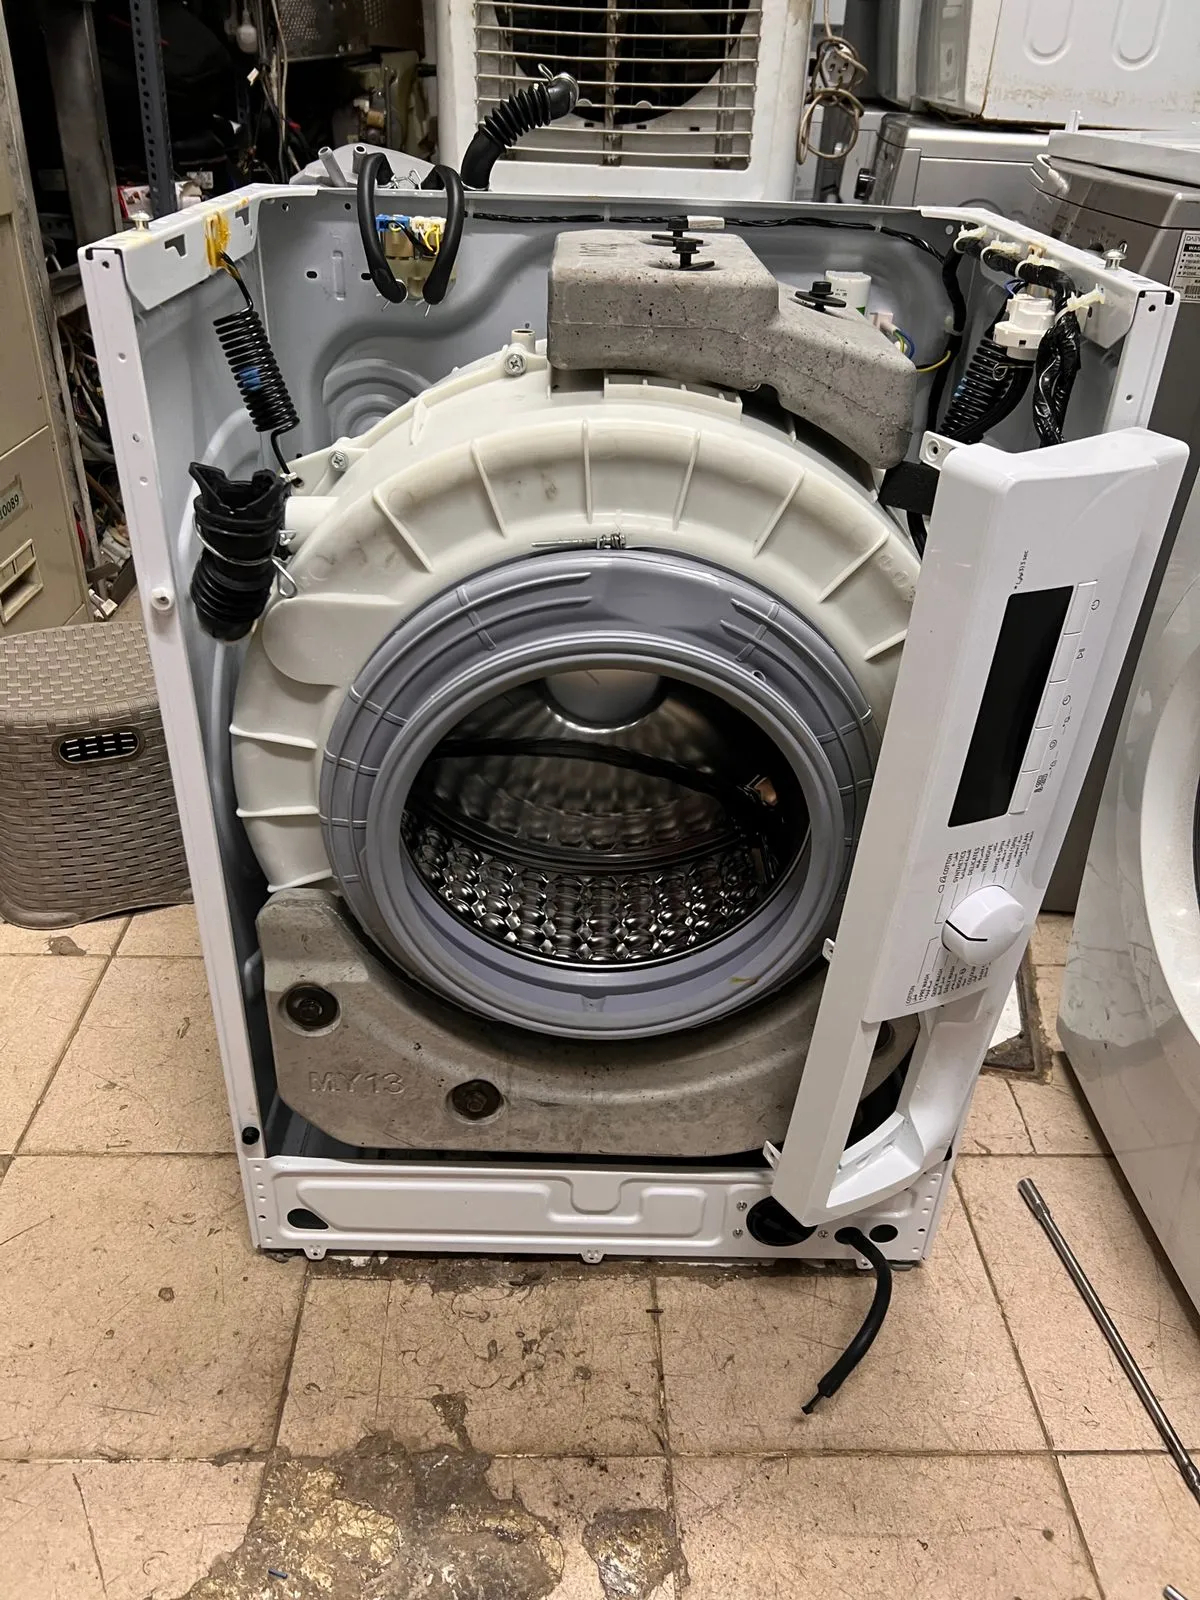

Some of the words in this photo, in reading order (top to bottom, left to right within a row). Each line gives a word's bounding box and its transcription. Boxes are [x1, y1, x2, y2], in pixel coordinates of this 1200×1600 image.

[942, 853, 953, 875] COTTON
[953, 851, 966, 882] SYNTHETICS
[967, 847, 980, 875] DELICATES
[906, 985, 915, 1003] COTTON
[308, 1072, 405, 1095] MY13
